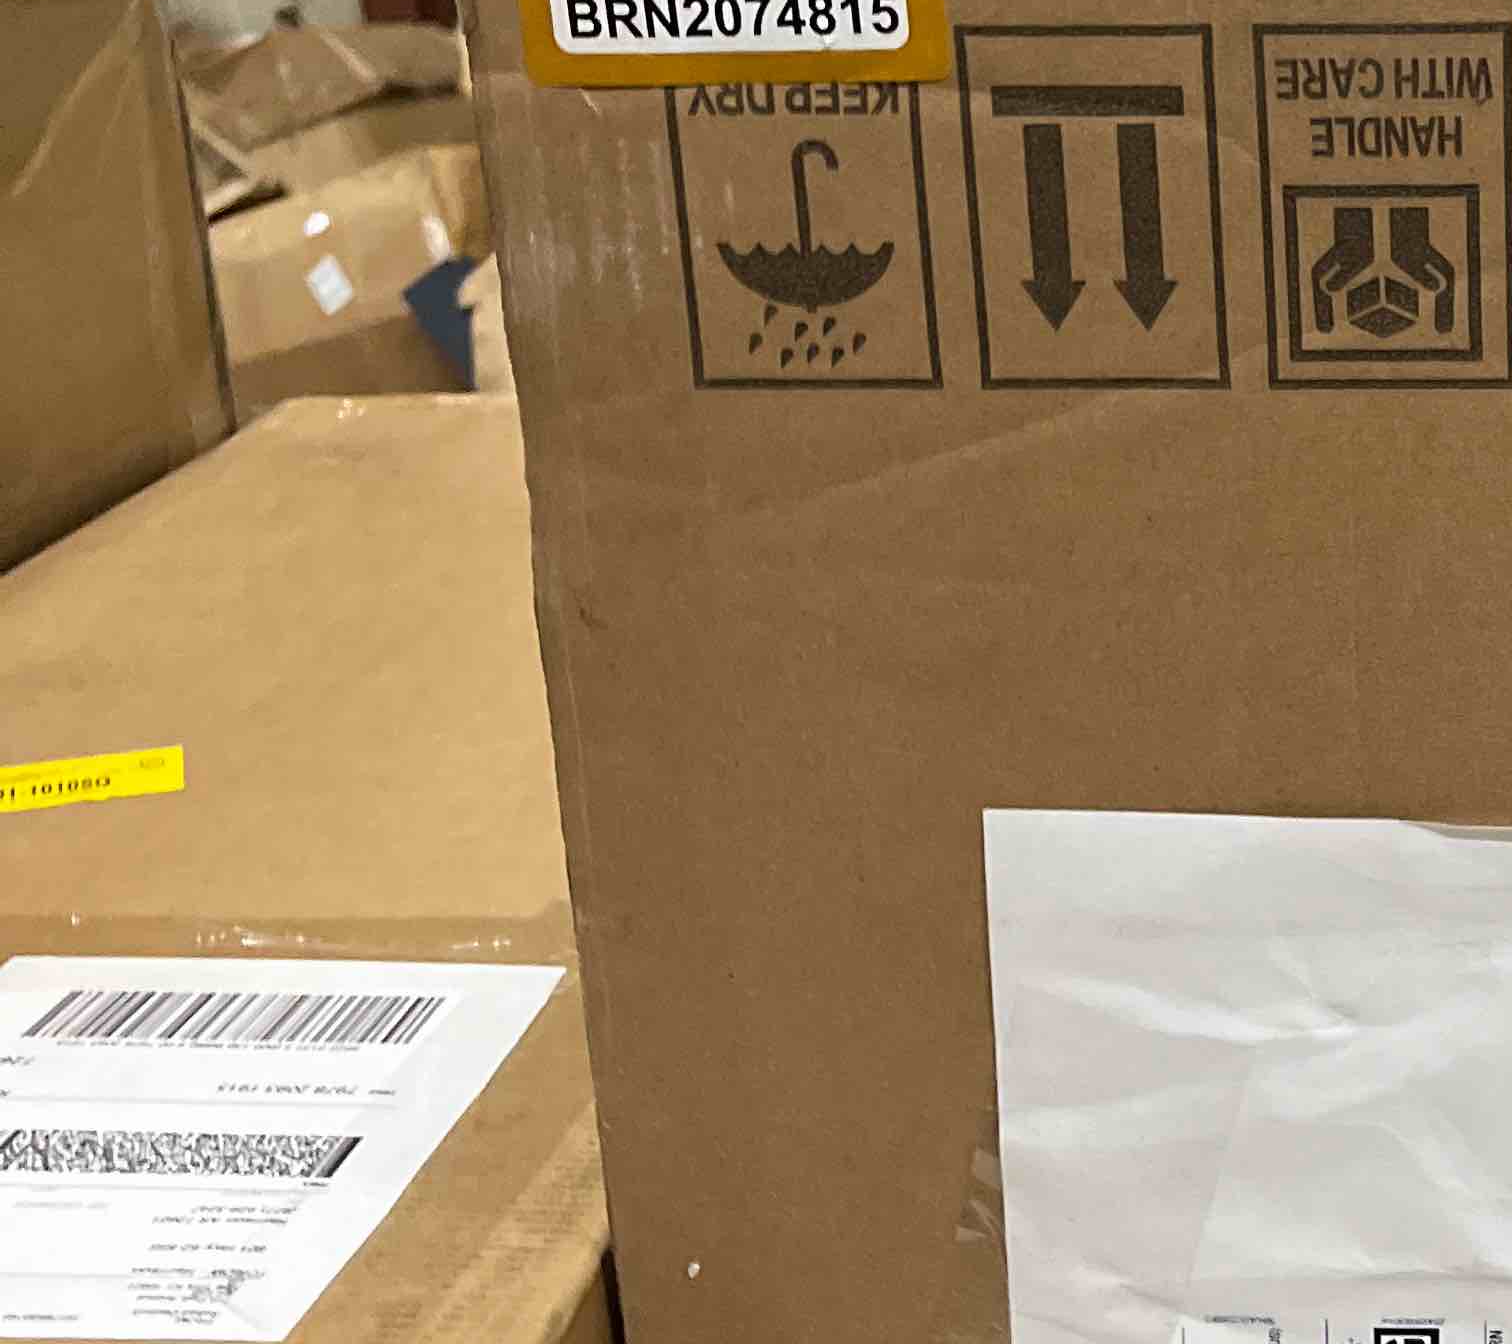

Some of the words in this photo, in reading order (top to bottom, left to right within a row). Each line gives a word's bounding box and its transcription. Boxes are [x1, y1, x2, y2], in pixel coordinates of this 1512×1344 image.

[1275, 57, 1384, 100] CARE
[1394, 56, 1494, 103] WITH
[1309, 115, 1463, 158] HANDLE
